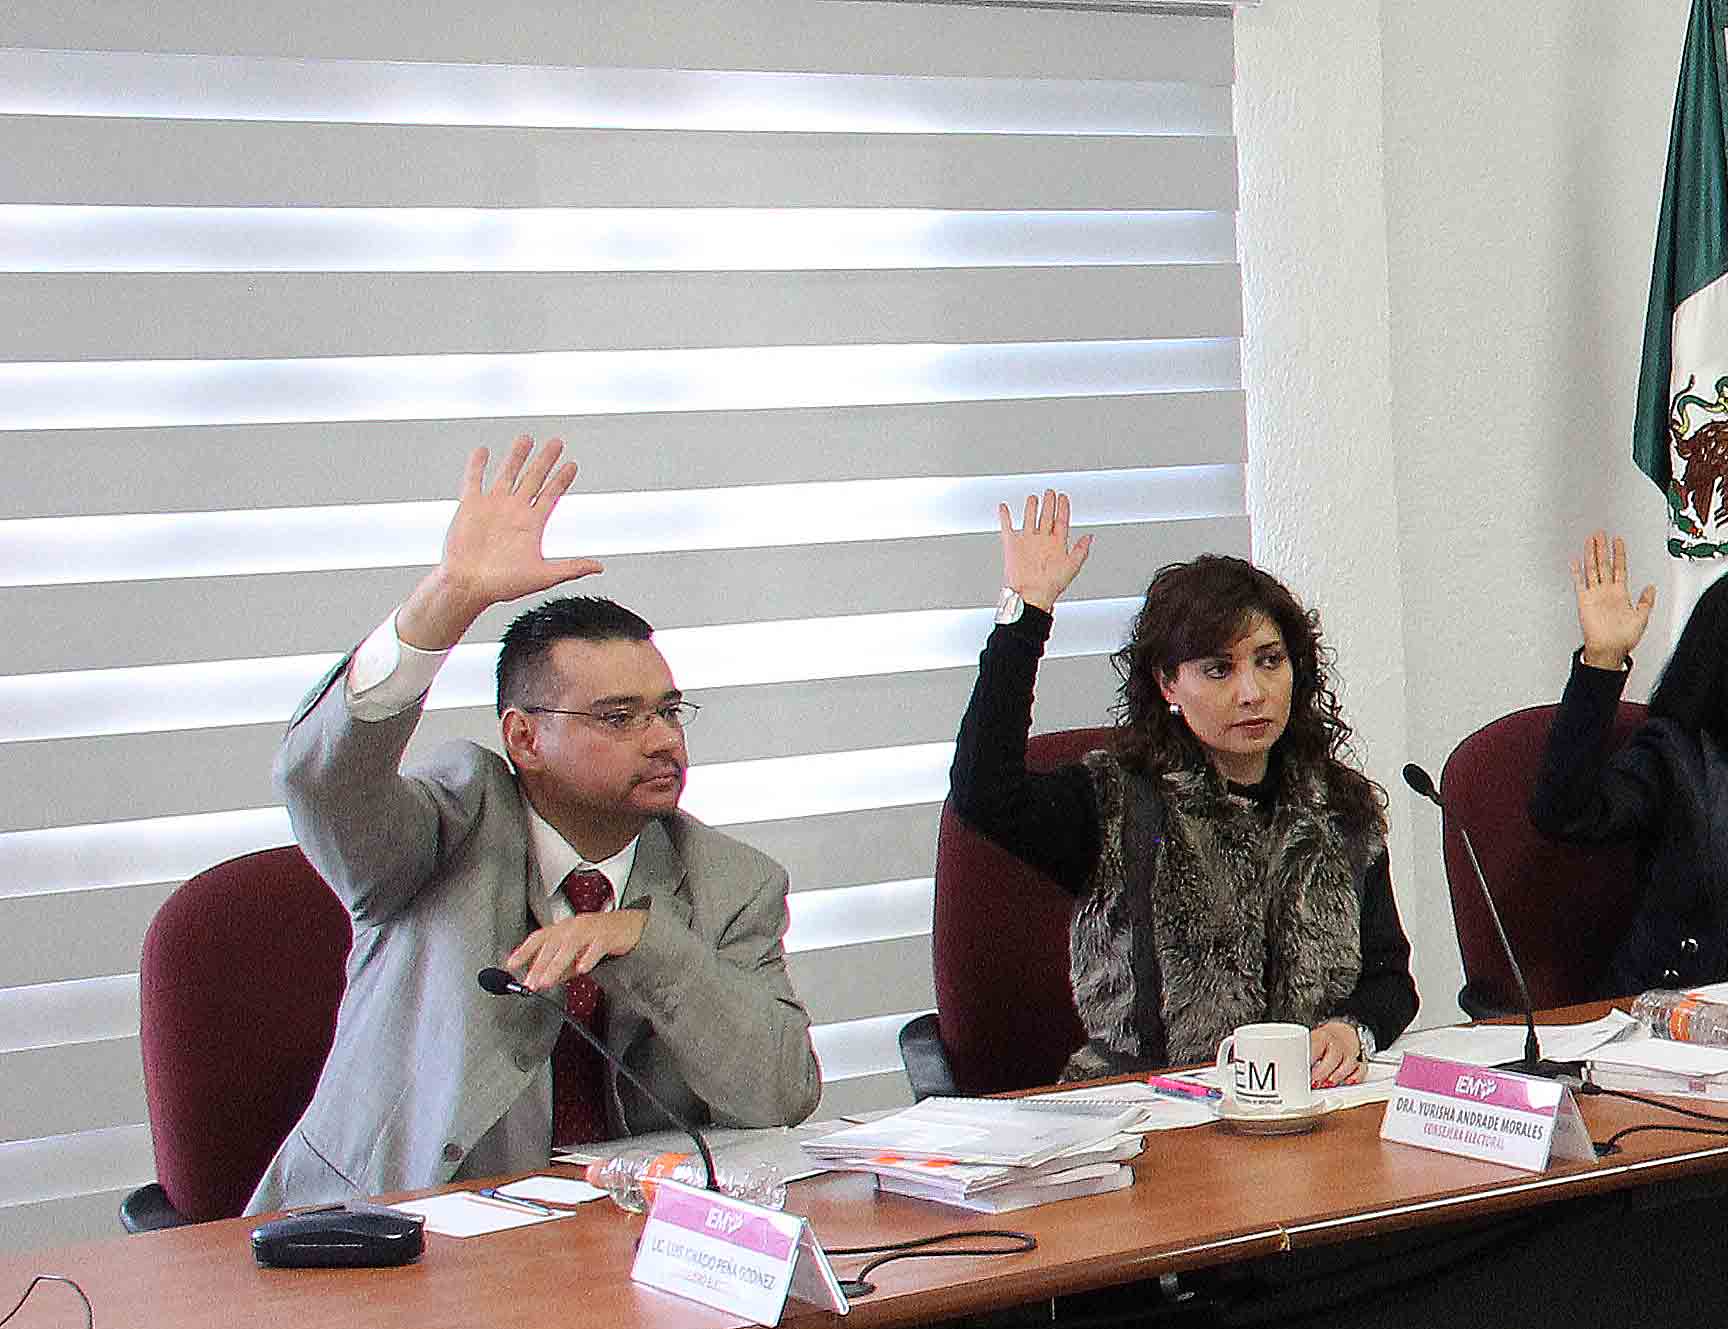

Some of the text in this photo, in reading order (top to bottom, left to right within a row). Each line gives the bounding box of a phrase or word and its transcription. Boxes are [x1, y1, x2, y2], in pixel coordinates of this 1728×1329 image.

[1395, 1097, 1544, 1141] DRA. YURISHA ANDRADE MORALES
